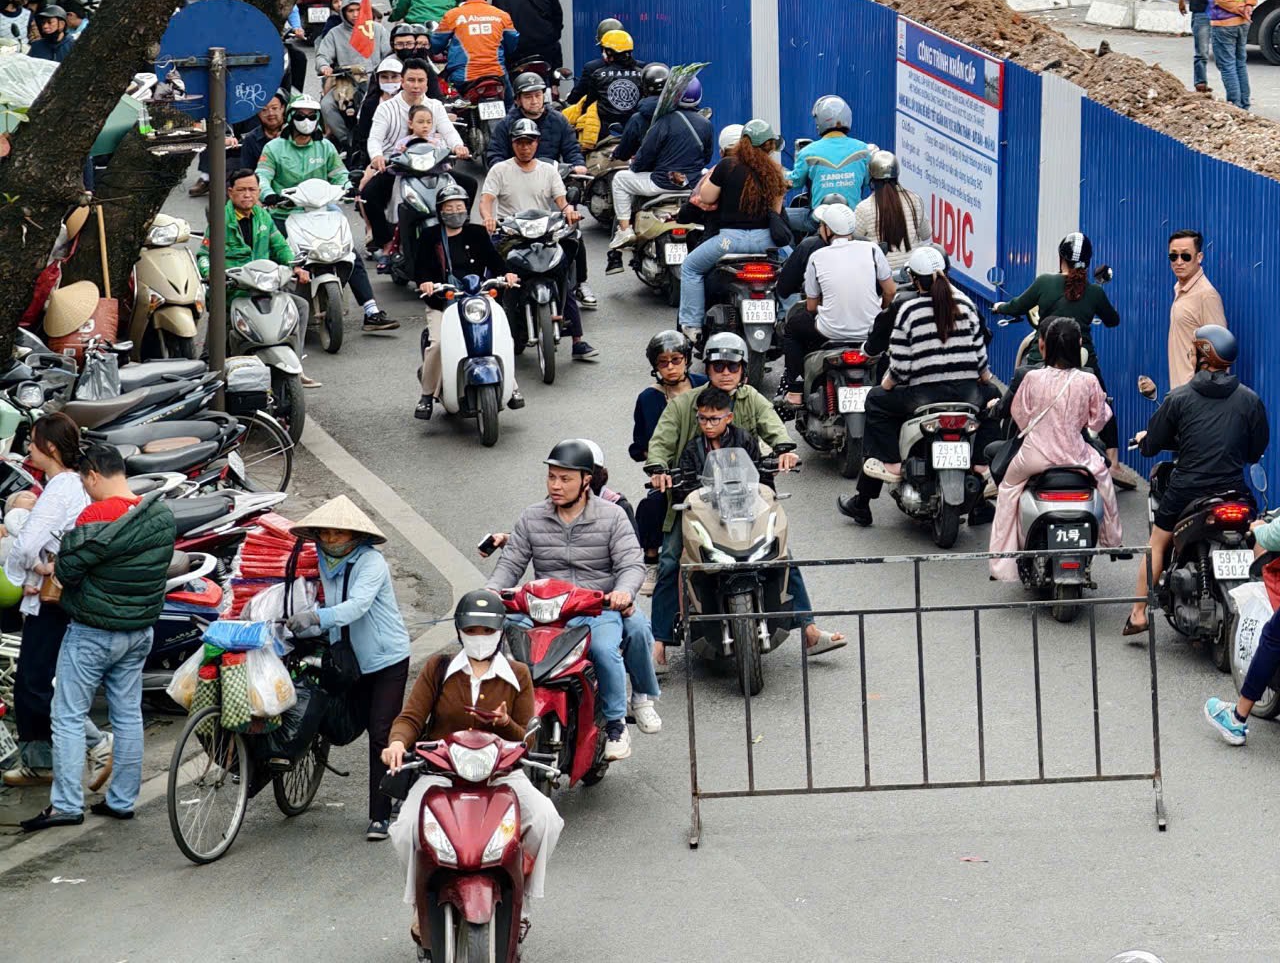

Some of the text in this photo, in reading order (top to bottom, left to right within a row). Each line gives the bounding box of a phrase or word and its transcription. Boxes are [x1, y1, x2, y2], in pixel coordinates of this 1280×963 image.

[918, 40, 933, 66] CÔNG
[932, 47, 949, 73] TRÌNH
[931, 193, 974, 269] UDIC
[1056, 529, 1080, 542] 九号
[1219, 552, 1248, 564] 59-X4
